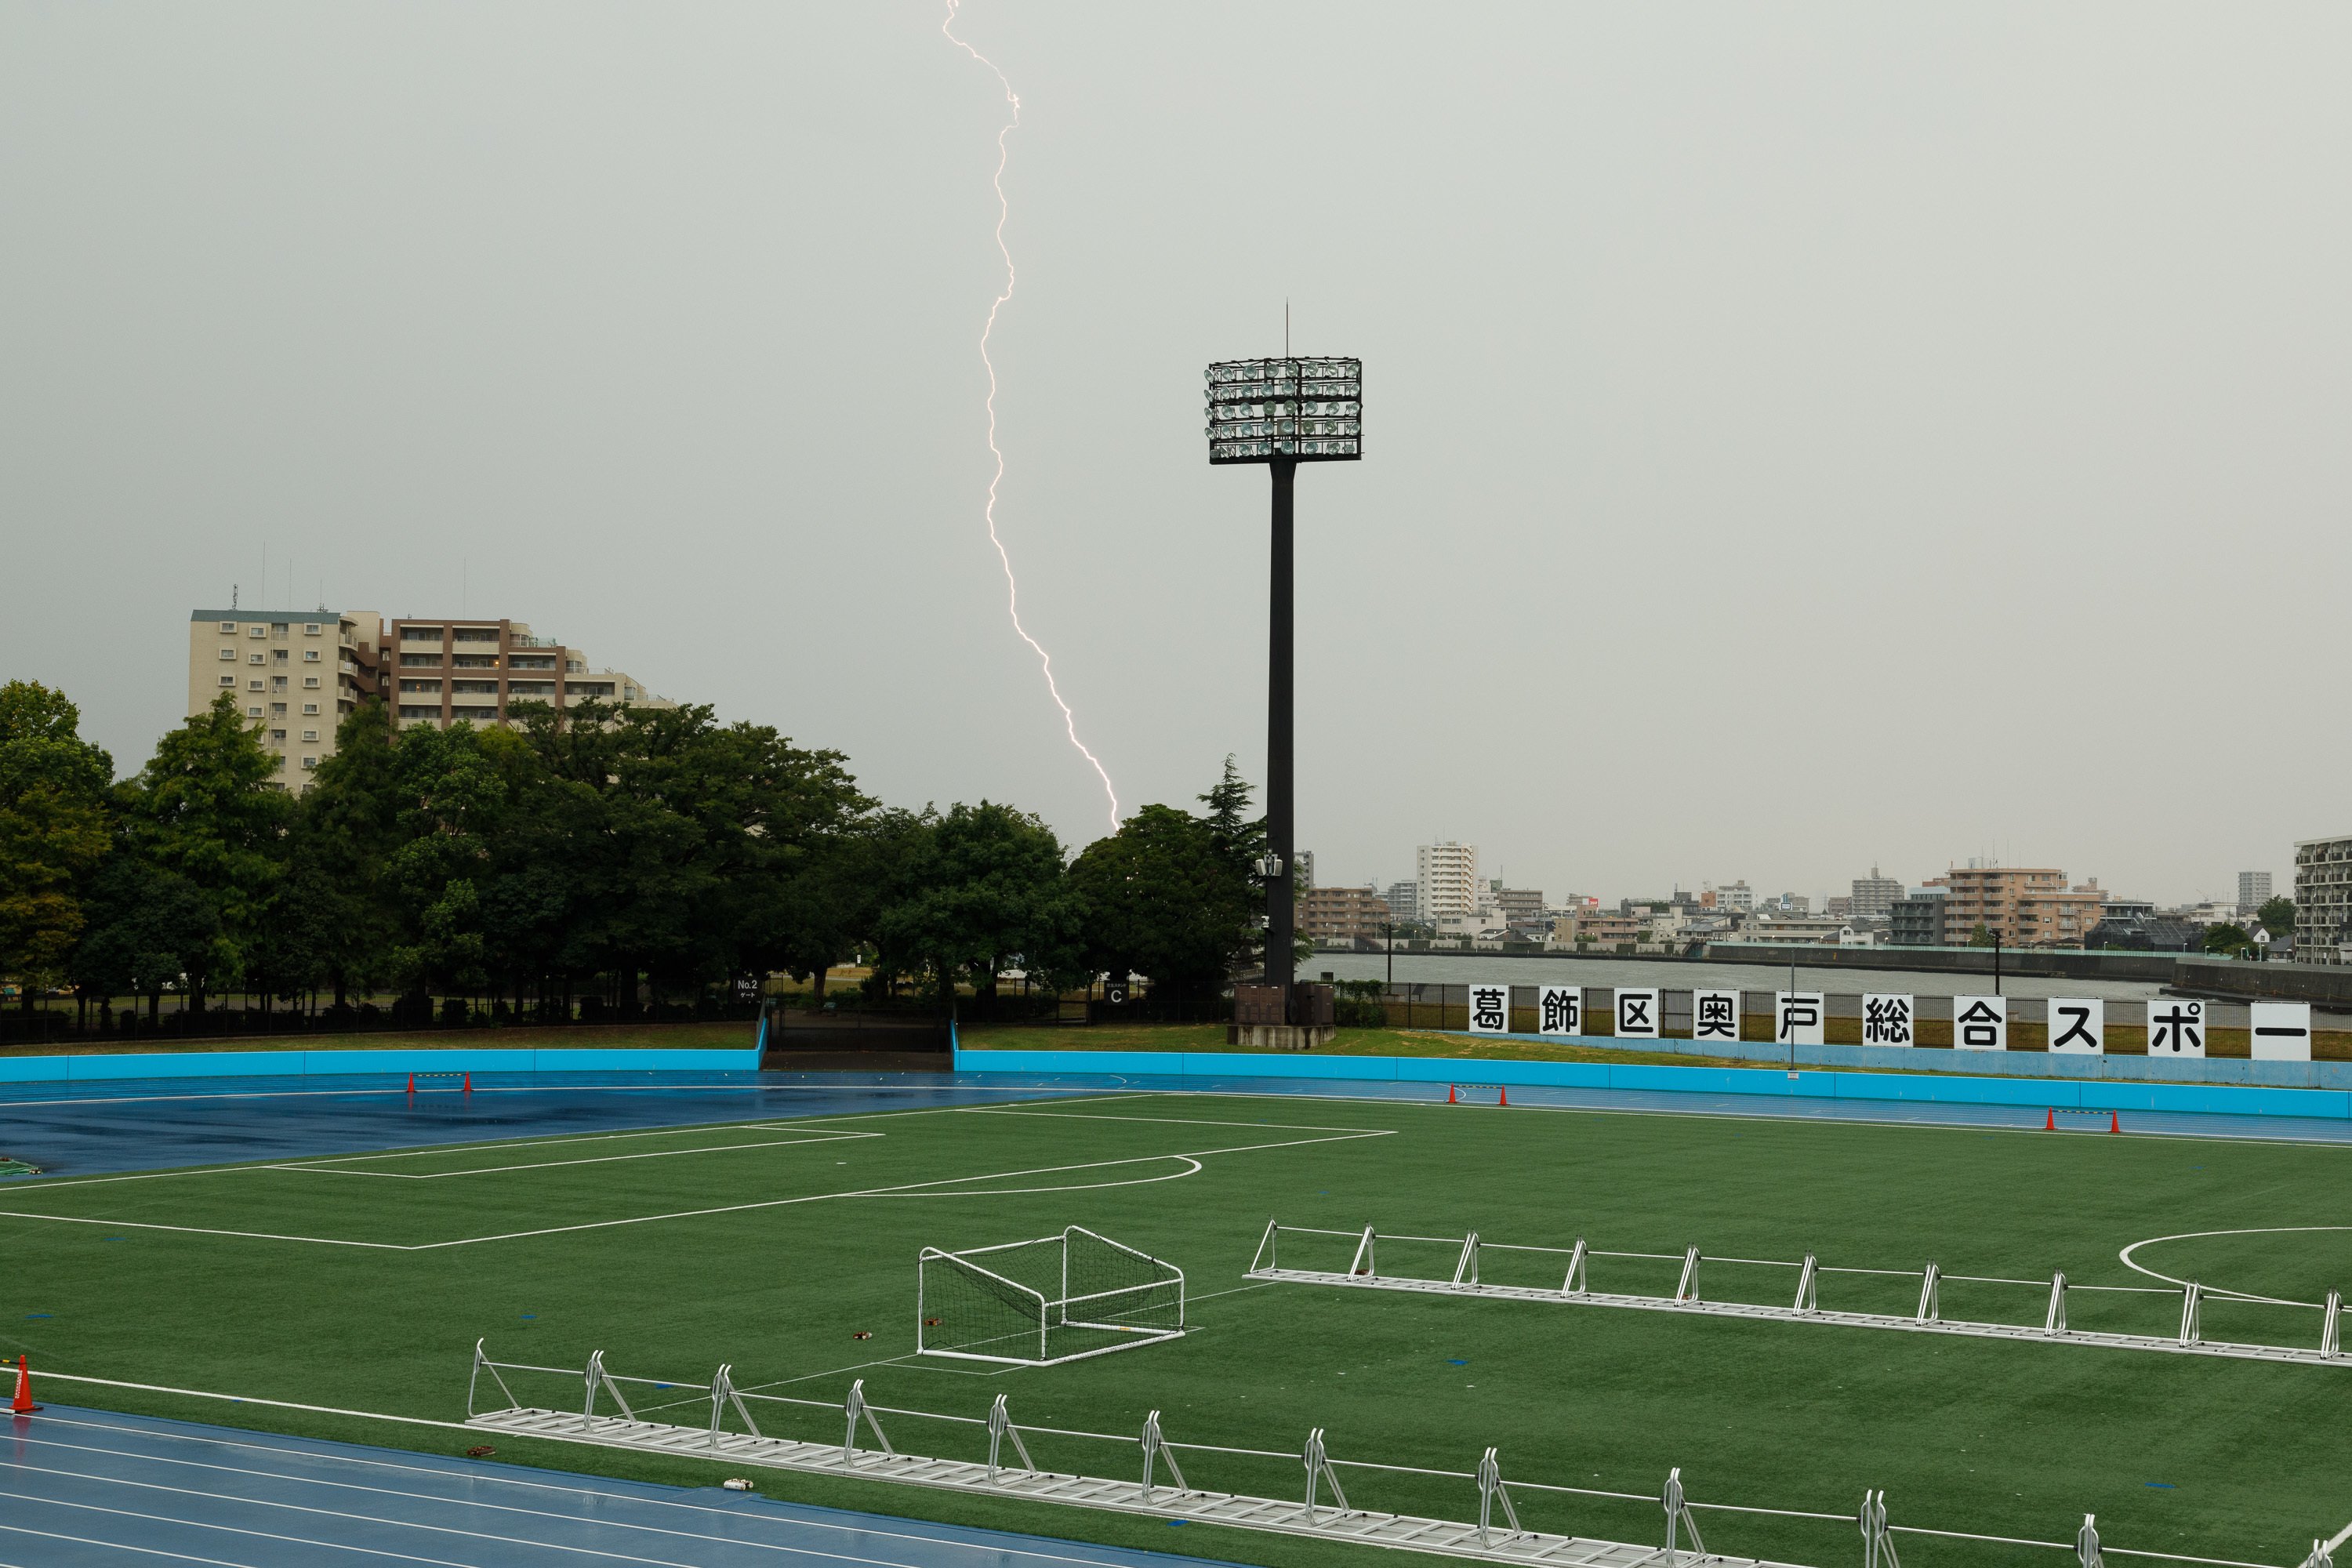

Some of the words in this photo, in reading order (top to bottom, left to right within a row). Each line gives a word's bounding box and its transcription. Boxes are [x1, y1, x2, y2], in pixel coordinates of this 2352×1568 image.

[738, 980, 757, 989] No.2
[1111, 989, 1122, 1003] C
[1473, 987, 2307, 1052] 葛飾区奥戸総合スポー
